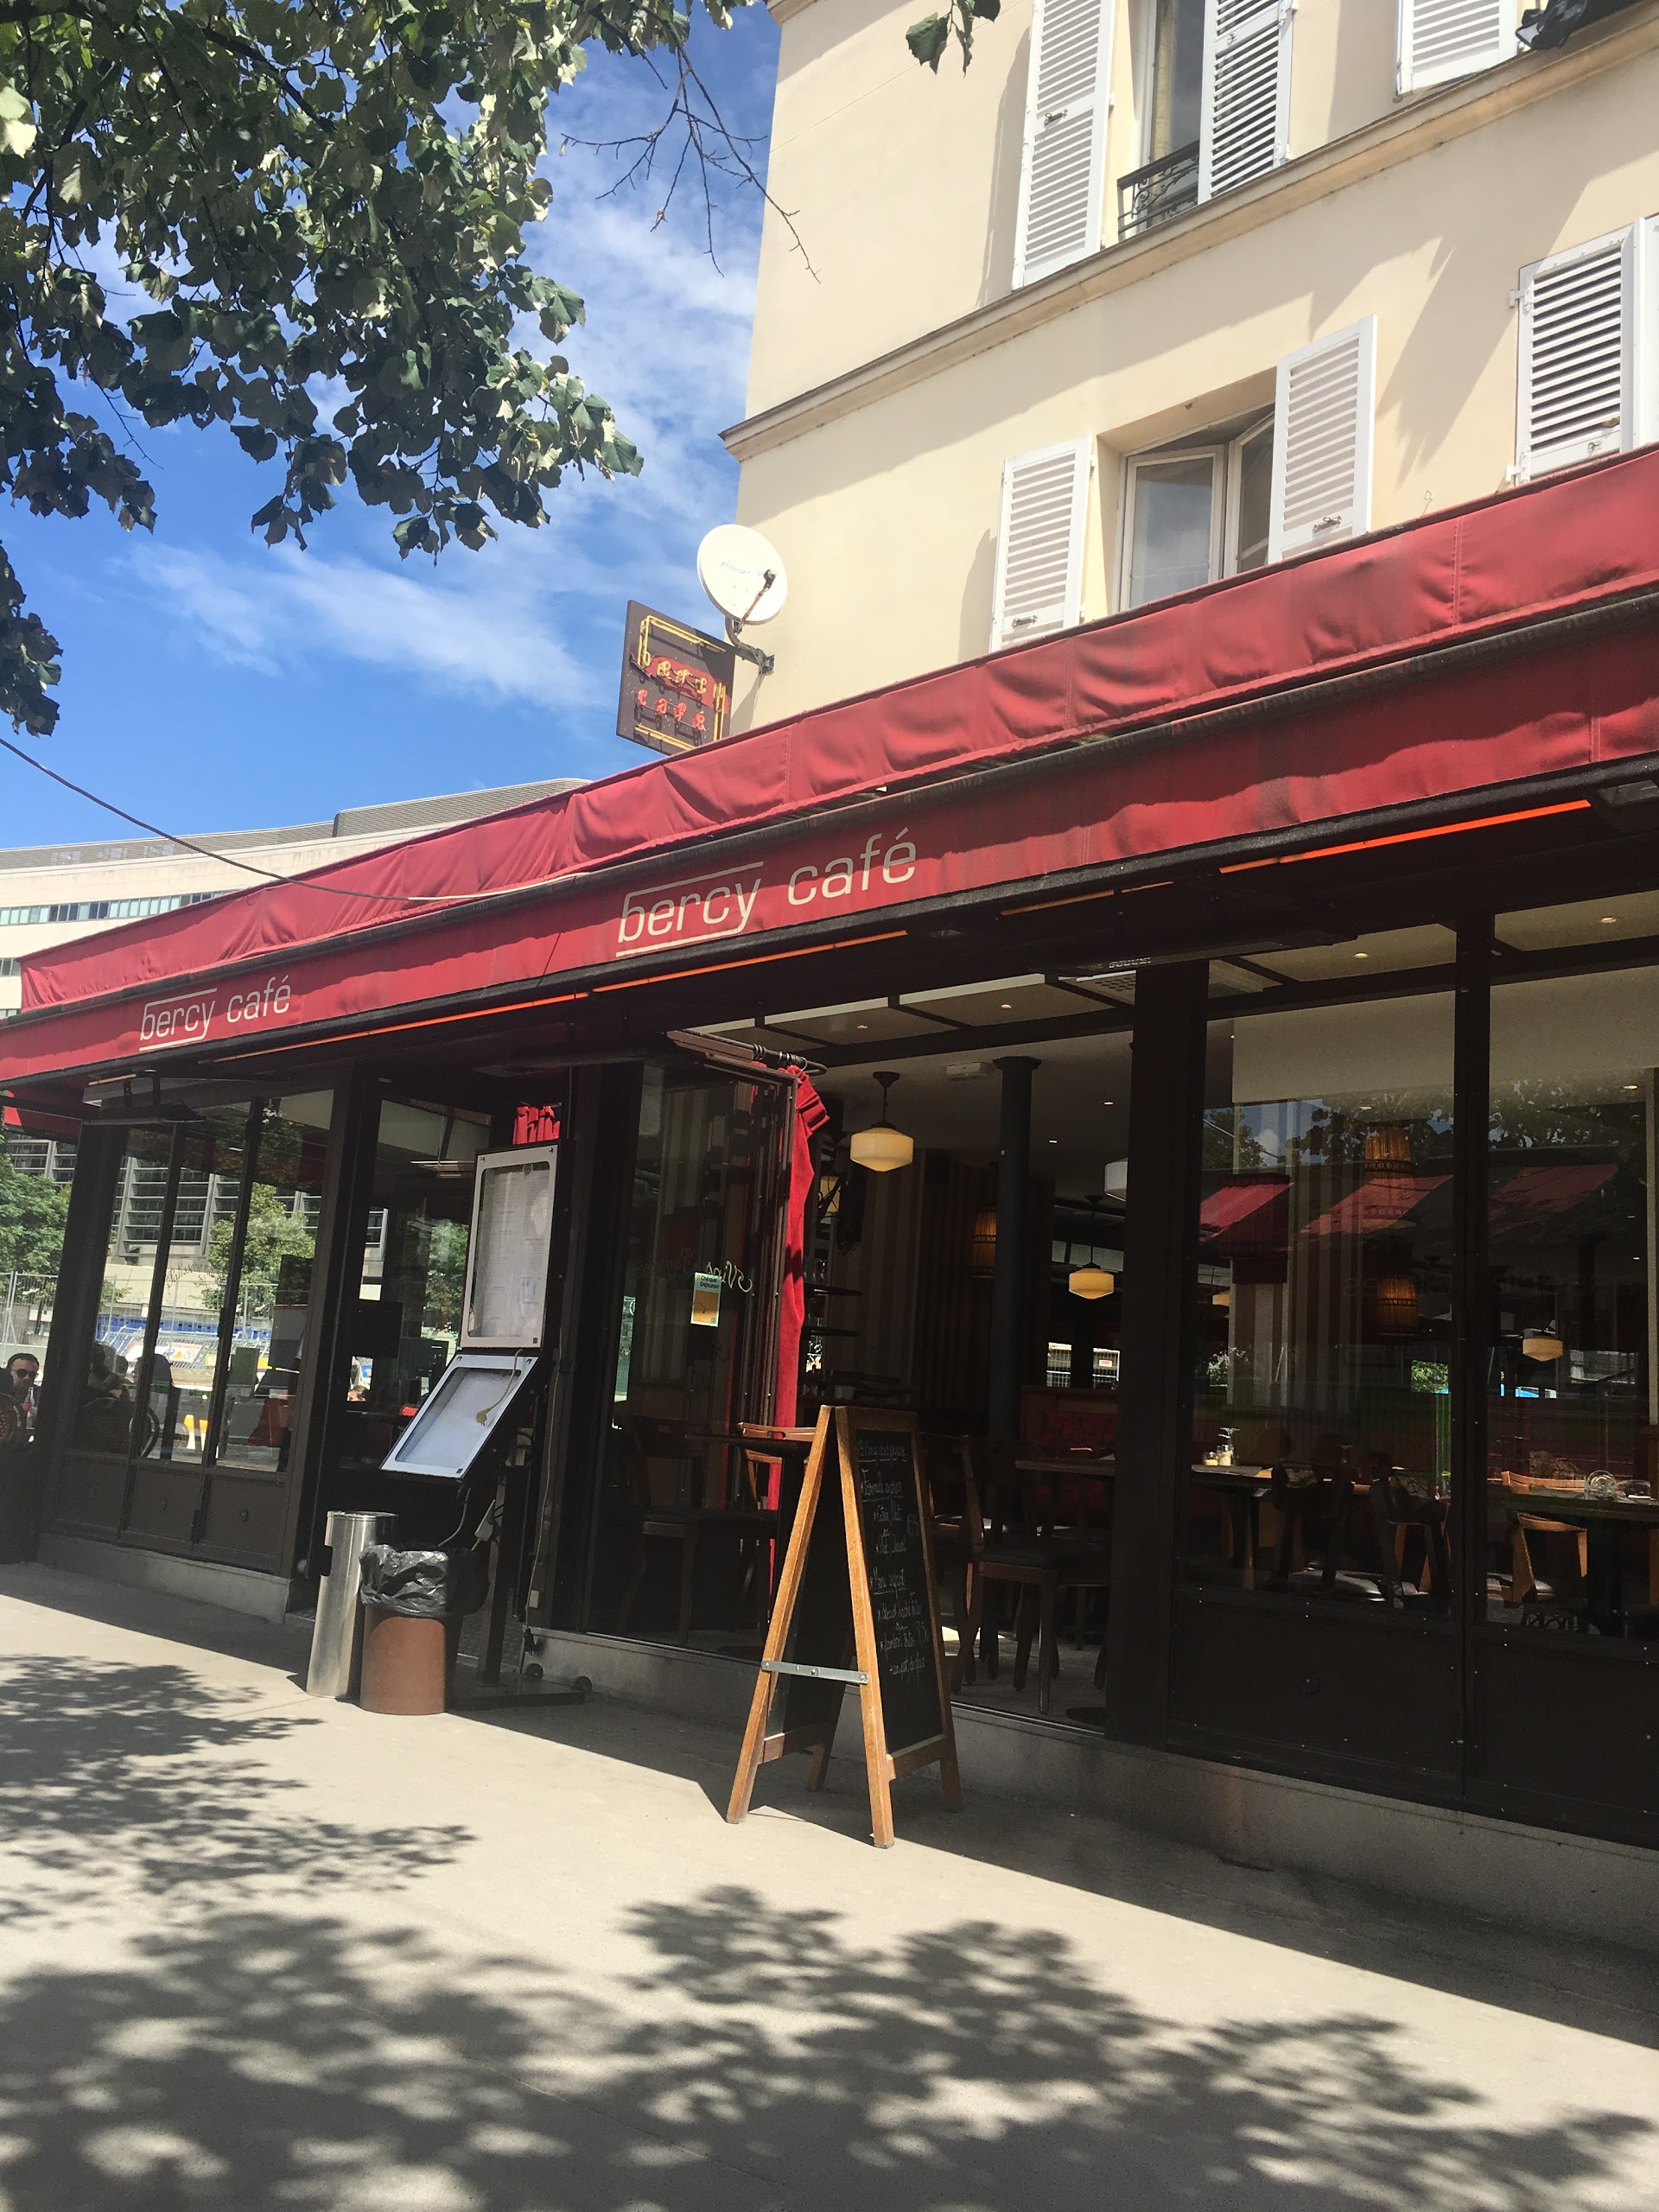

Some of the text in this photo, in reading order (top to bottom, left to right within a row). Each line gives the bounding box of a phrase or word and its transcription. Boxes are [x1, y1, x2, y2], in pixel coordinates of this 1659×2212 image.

[616, 827, 917, 957] bercy café
[139, 975, 291, 1052] bercy café
